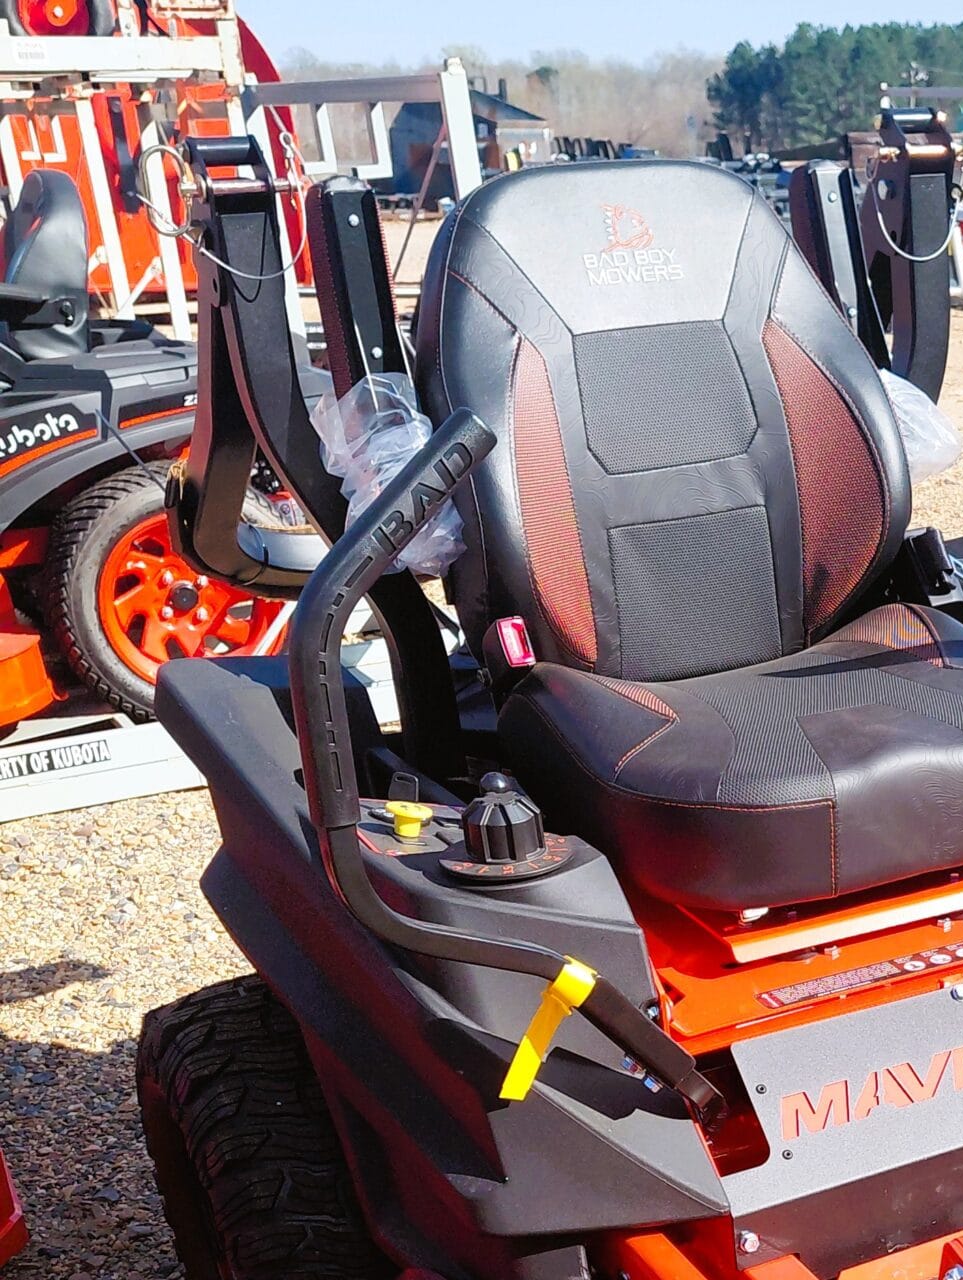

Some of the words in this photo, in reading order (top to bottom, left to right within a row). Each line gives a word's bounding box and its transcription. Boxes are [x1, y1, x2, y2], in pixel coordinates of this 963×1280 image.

[583, 250, 629, 268] BAD
[633, 248, 677, 265] BOY
[586, 264, 684, 287] MOWERS
[0, 412, 79, 457] ubota
[370, 441, 474, 559] BAD
[0, 754, 28, 780] RTY
[29, 750, 50, 773] OF
[50, 740, 111, 770] KUBOTA
